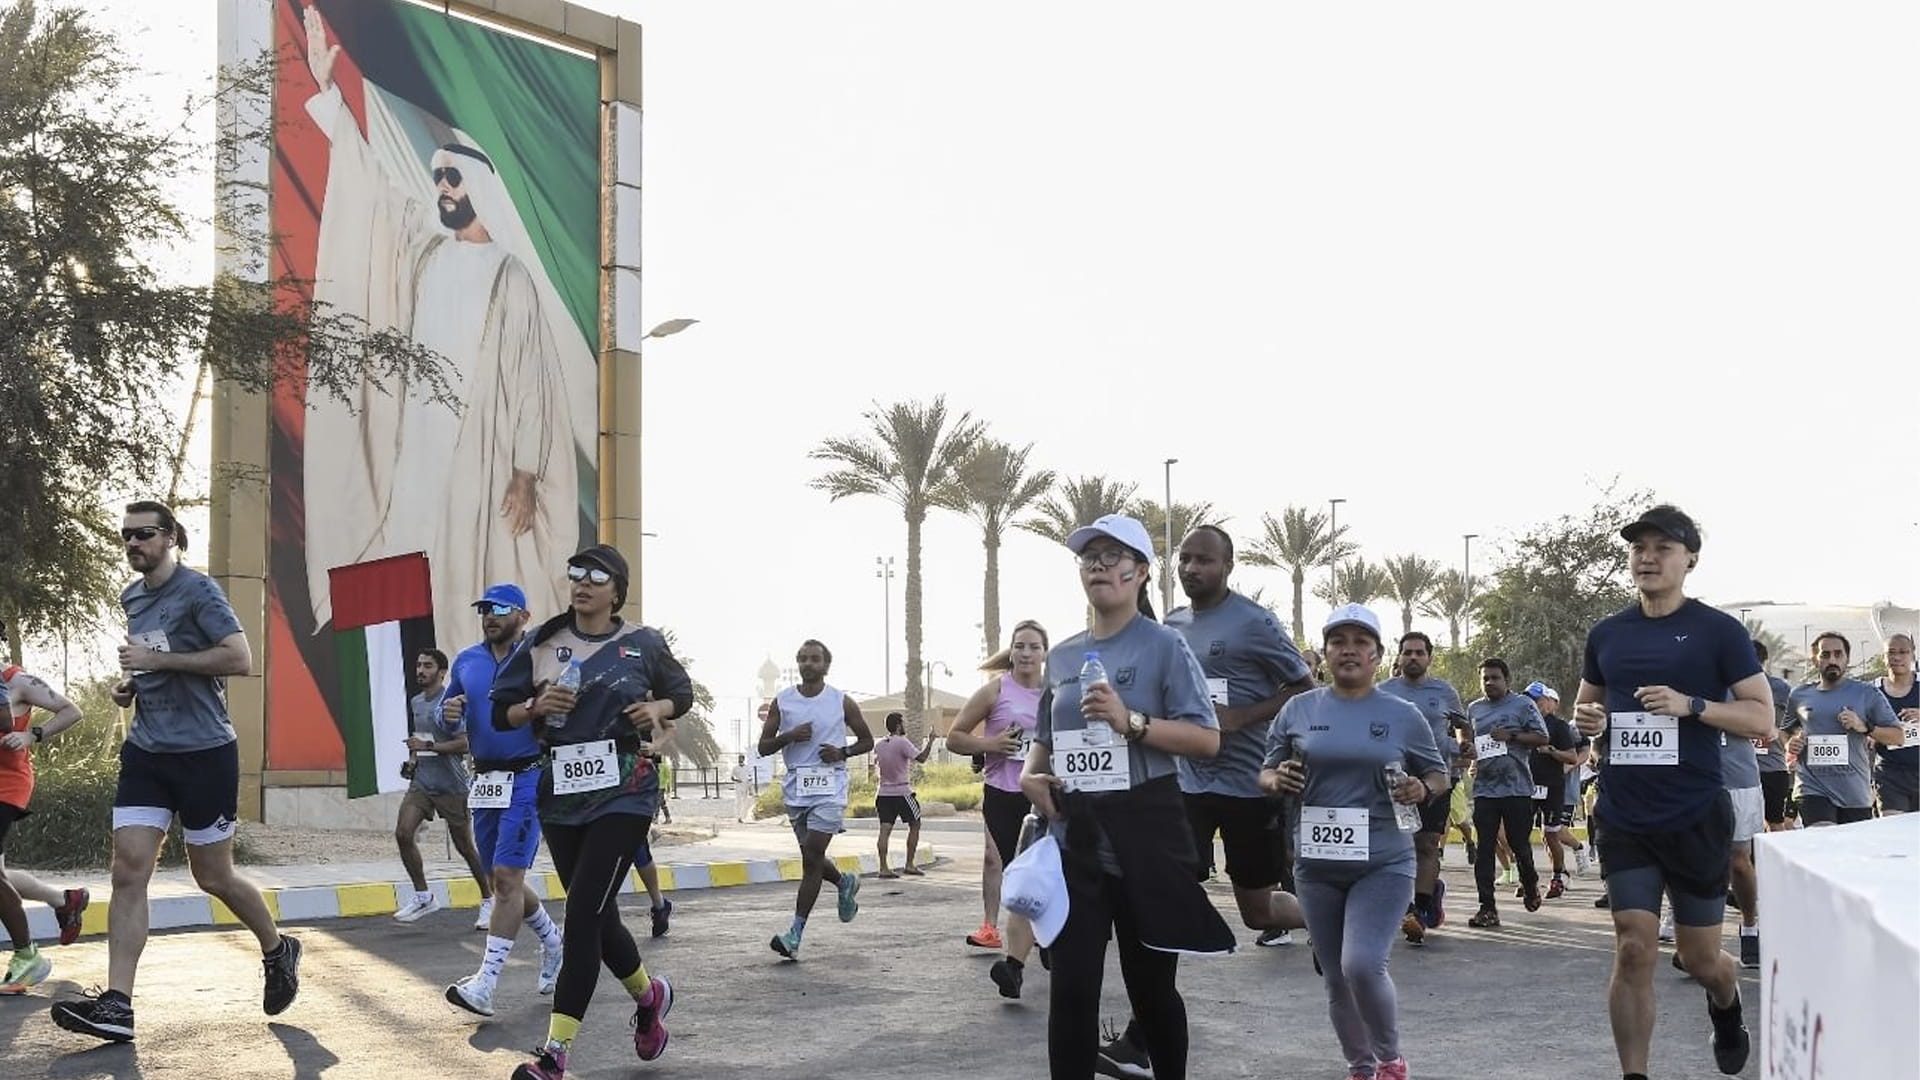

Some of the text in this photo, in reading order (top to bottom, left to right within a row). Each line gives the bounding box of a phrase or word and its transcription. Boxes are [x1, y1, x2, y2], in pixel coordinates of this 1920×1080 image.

[1621, 730, 1663, 748] 8440
[1813, 746, 1840, 756] 8080
[564, 759, 605, 779] 8802
[1066, 751, 1113, 773] 8302
[1312, 825, 1354, 844] 8292
